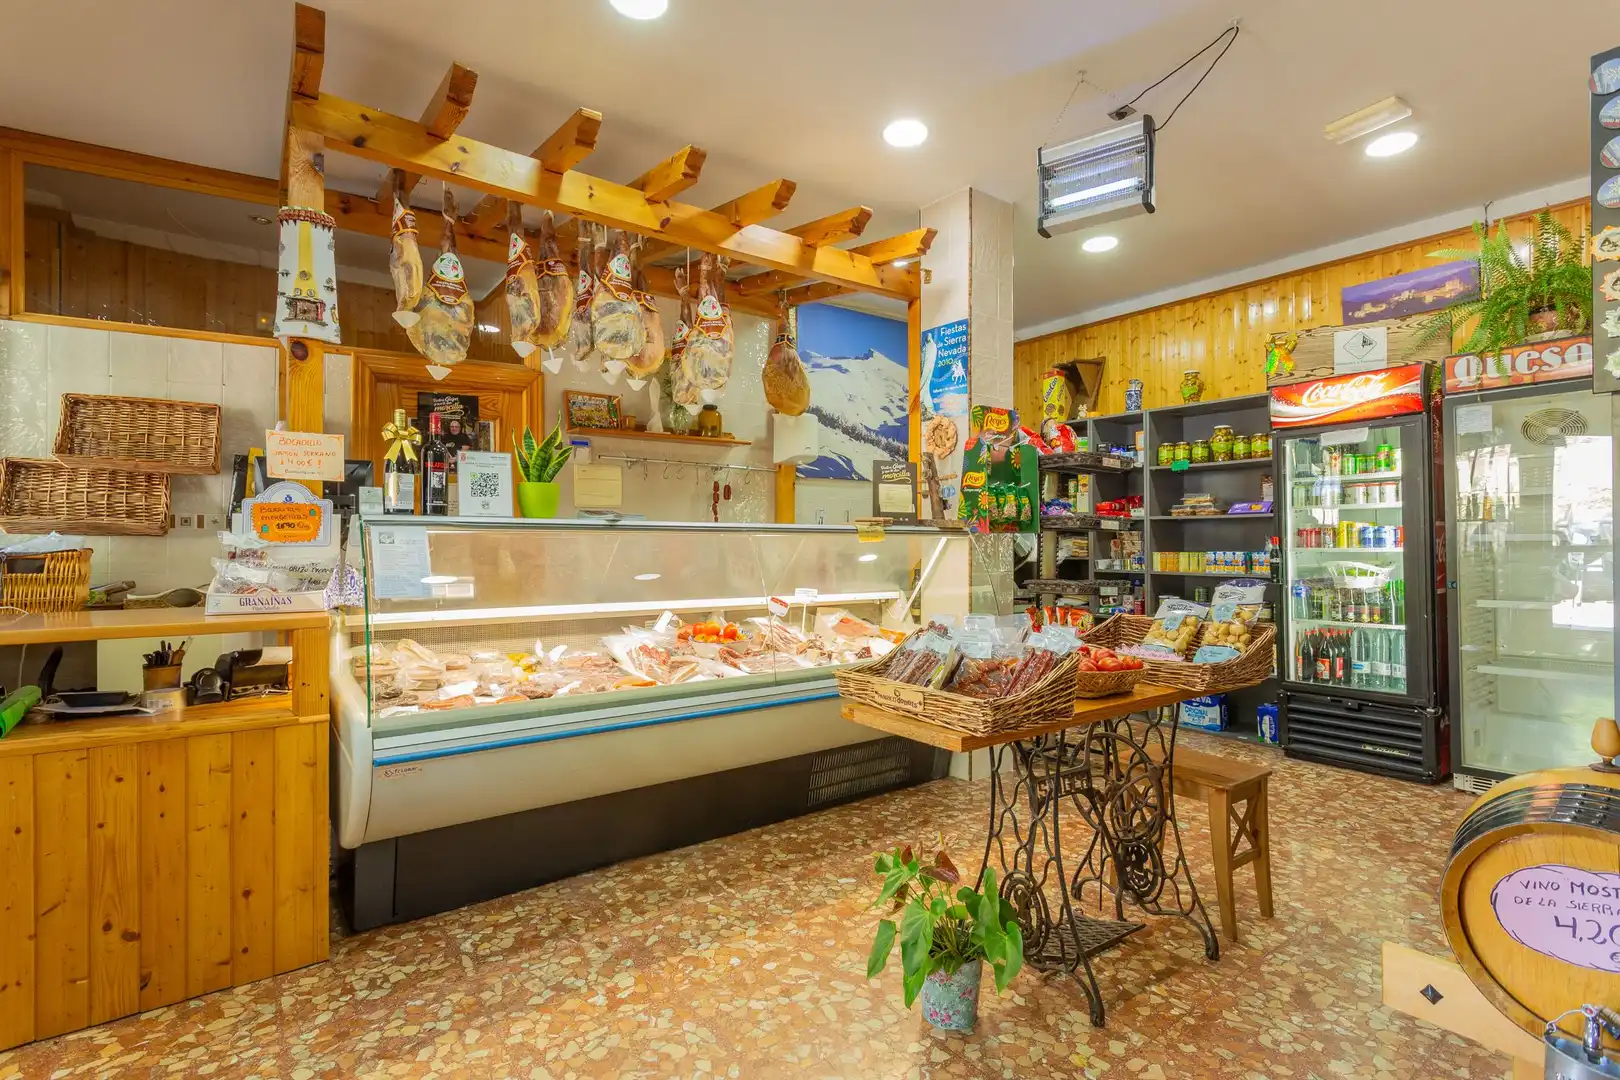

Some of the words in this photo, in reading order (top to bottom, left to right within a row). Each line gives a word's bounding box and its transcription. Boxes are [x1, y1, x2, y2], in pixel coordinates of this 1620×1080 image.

[941, 324, 967, 336] Fiestas
[944, 335, 967, 346] Sierra
[938, 345, 967, 357] Nevada
[1302, 372, 1390, 407] Coca-Cola
[985, 416, 1007, 427] Reyes
[1520, 880, 1561, 891] VINO
[1514, 896, 1532, 905] DE
[1538, 897, 1557, 908] LA
